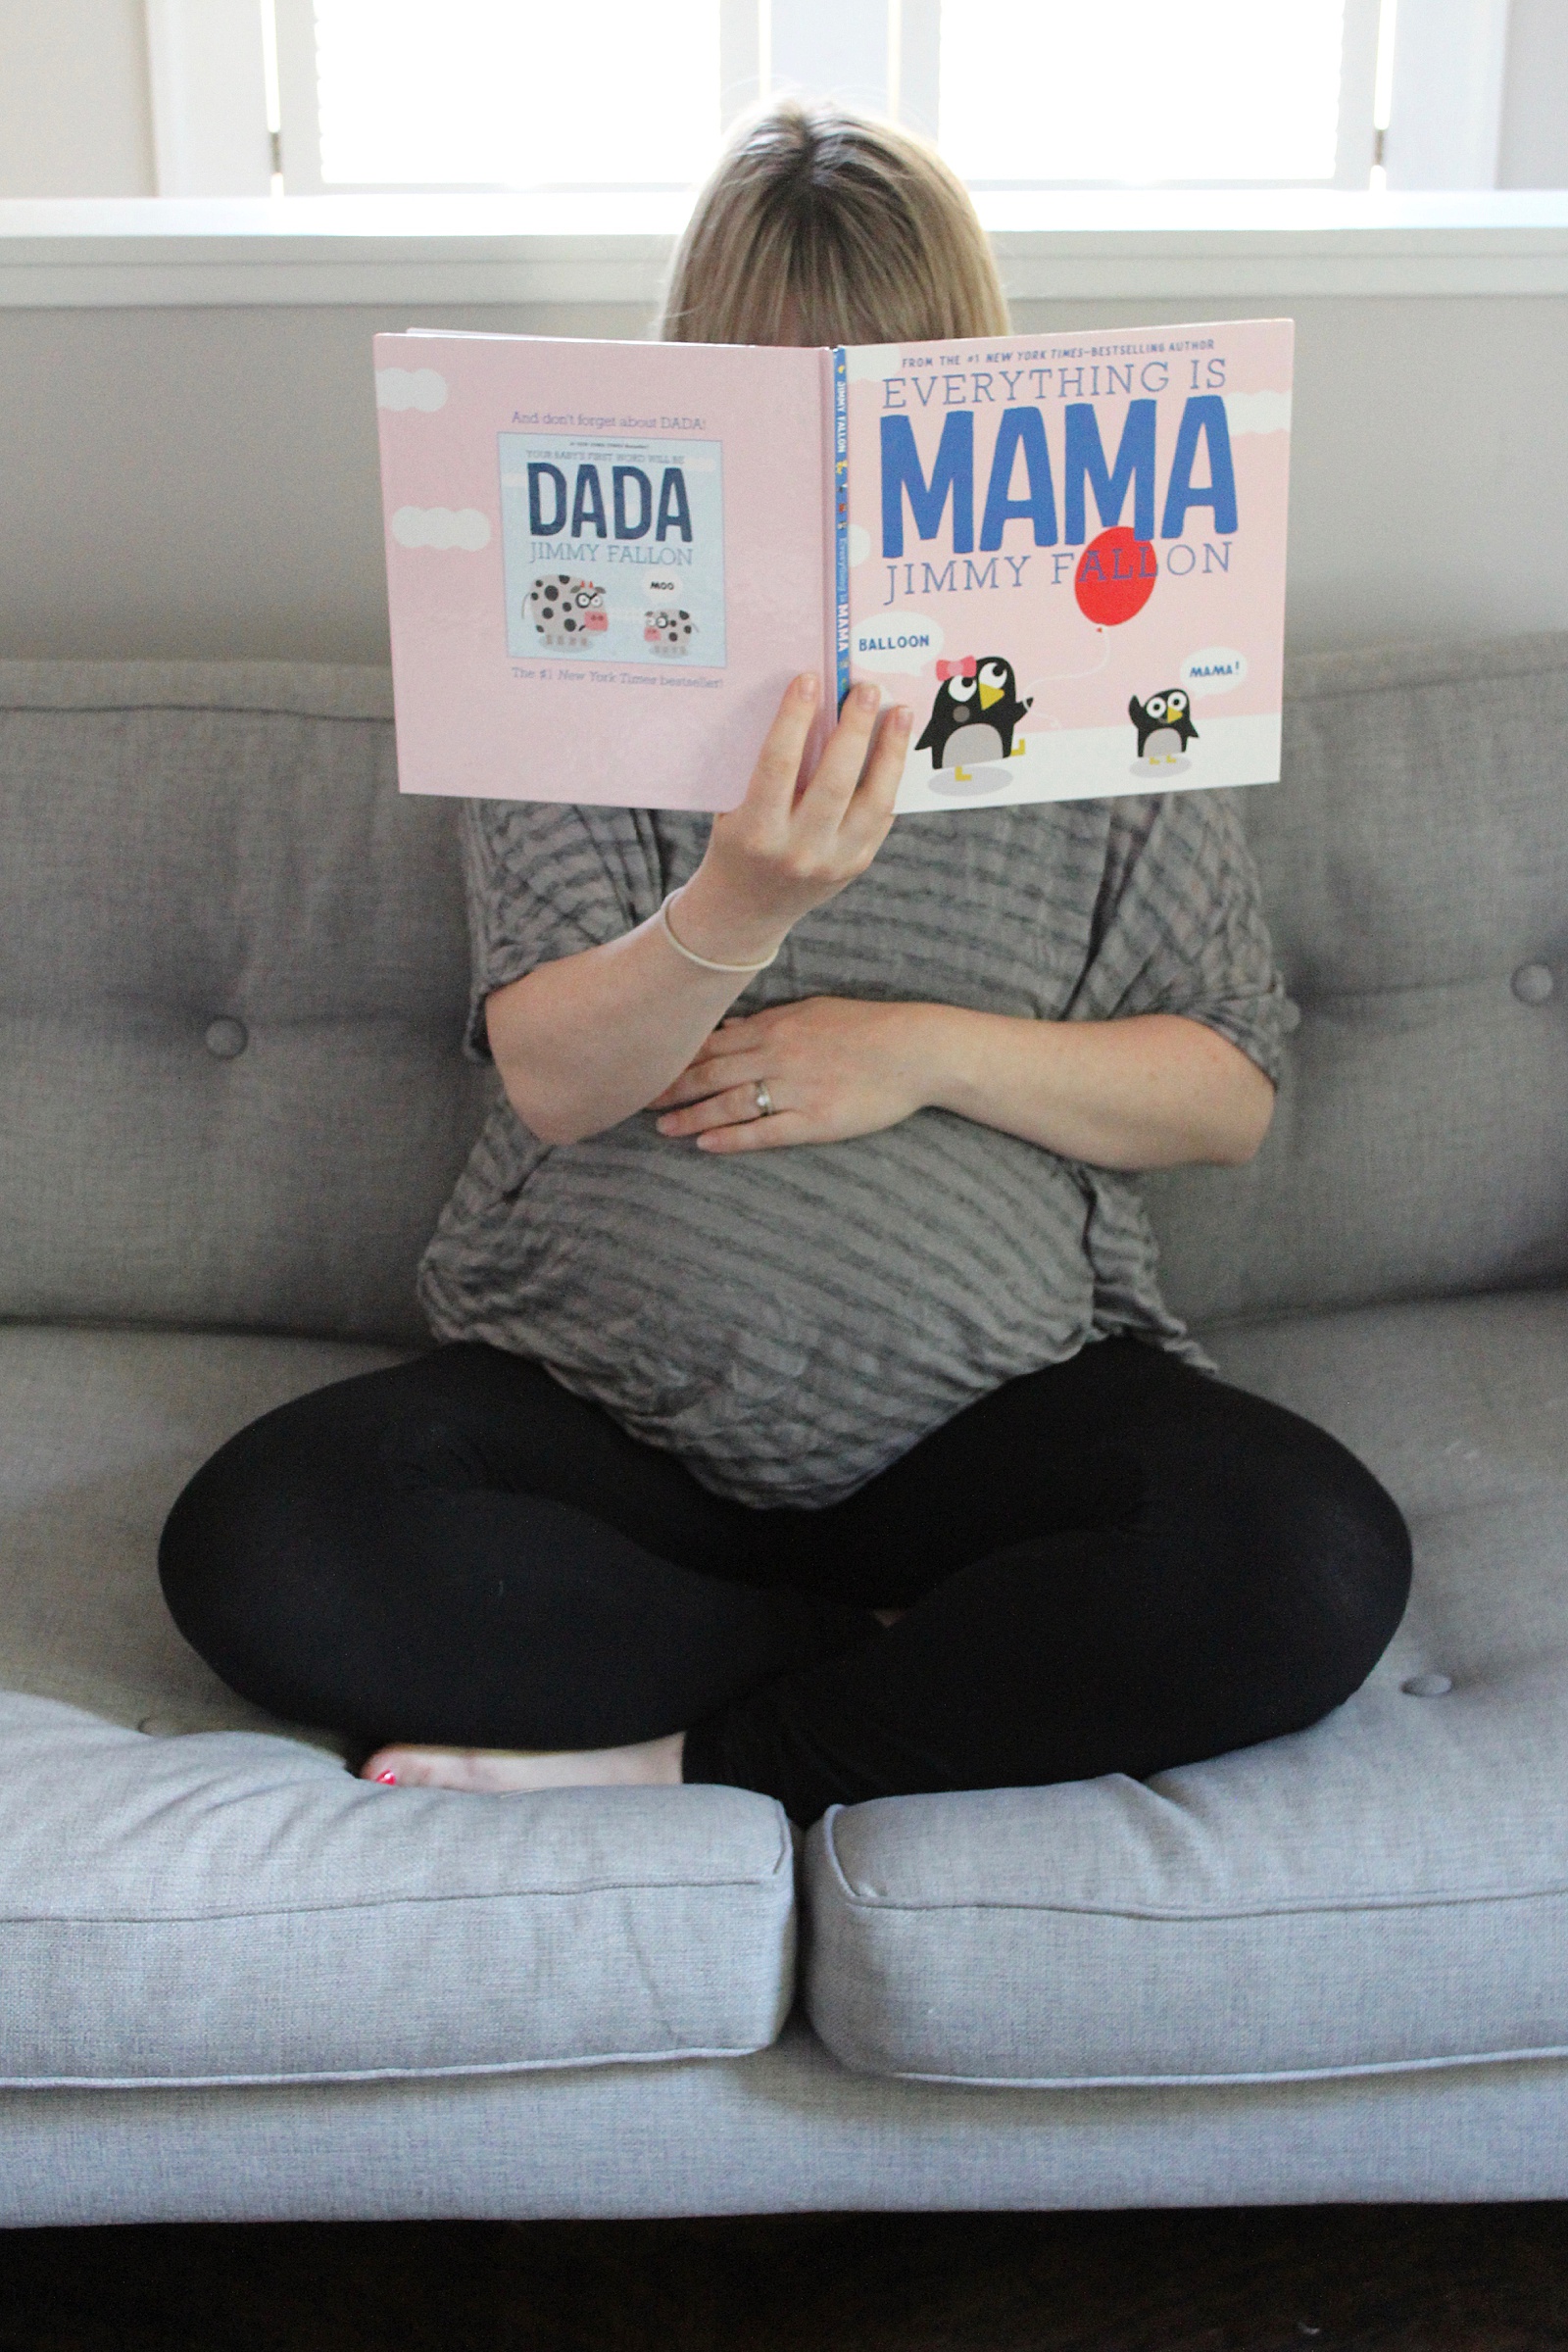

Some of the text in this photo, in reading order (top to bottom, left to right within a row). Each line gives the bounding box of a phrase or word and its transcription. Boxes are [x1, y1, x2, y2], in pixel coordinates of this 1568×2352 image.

[902, 358, 933, 368] FROM
[939, 355, 960, 366] THE
[967, 353, 980, 364] #1
[986, 352, 1013, 363] NEW
[1017, 349, 1047, 361] YORK
[1169, 338, 1214, 352] AUTHOR
[881, 358, 1227, 410] EVERYTHING IS
[512, 411, 539, 423] And
[577, 414, 615, 429] forget
[619, 416, 657, 428] about
[836, 381, 849, 454] JIMMY FALLON
[880, 394, 1239, 559] MAMA
[526, 462, 693, 543] DADA
[529, 542, 694, 566] JIMMY FALLON
[650, 580, 674, 590] MOO
[883, 541, 1234, 606] JIMMY FALLON
[838, 604, 850, 652] MAMA
[858, 634, 930, 652] BALLOON
[512, 666, 535, 678] The
[558, 669, 585, 680] New
[590, 671, 615, 682] York
[619, 672, 657, 684] Times
[1189, 661, 1240, 678] MAMA!
